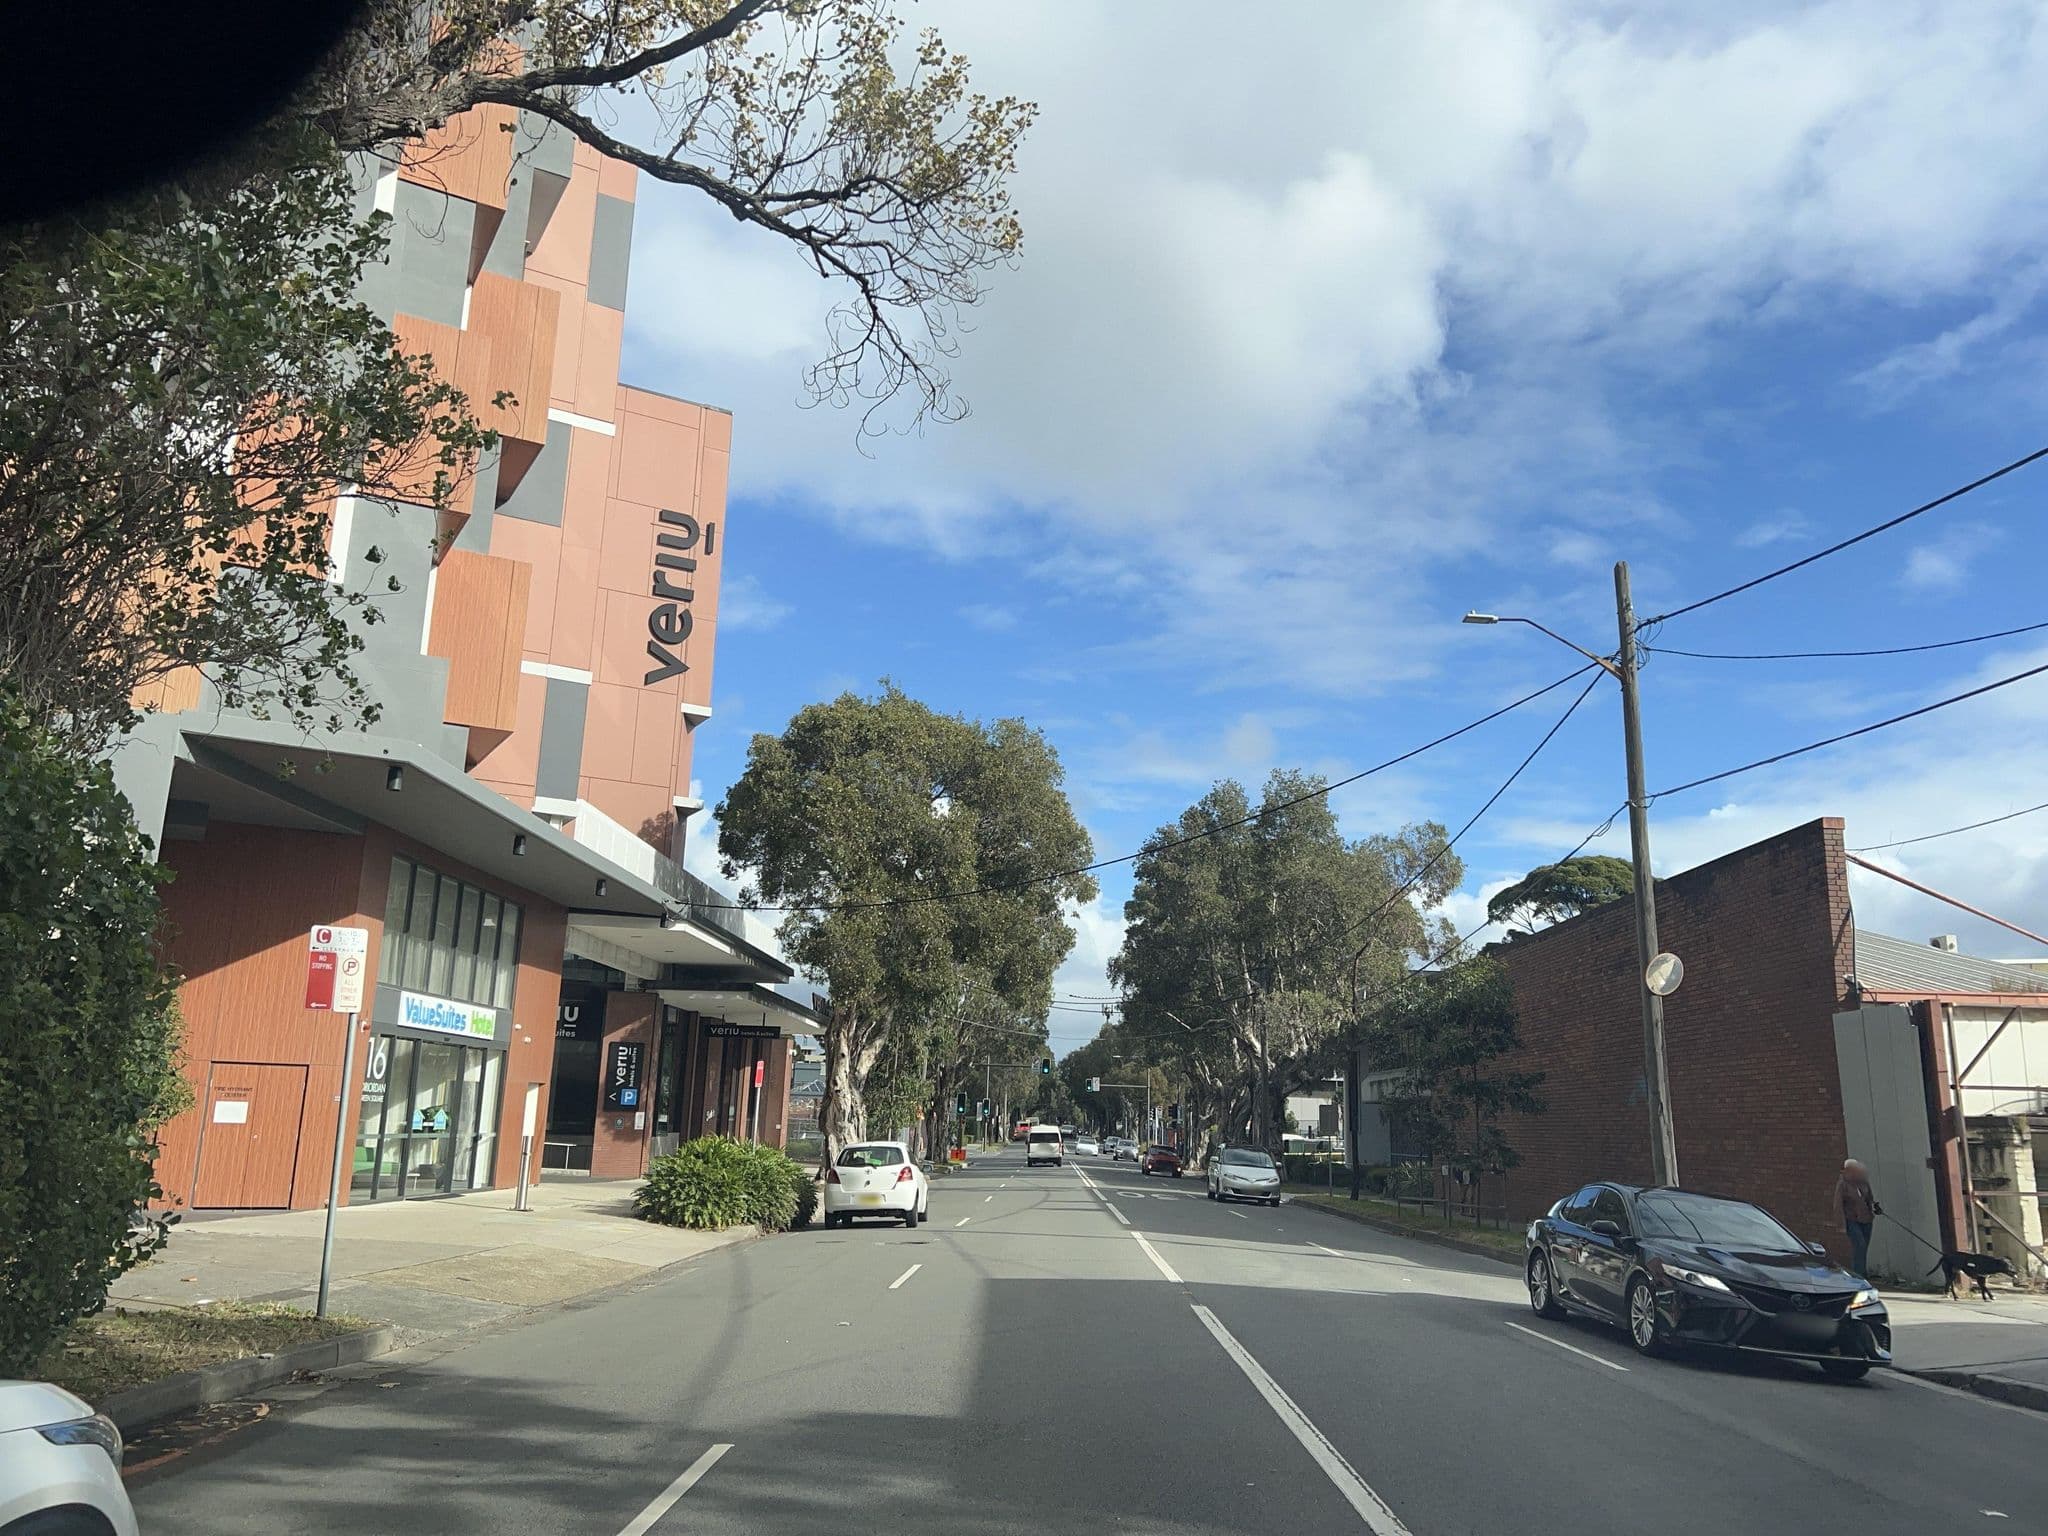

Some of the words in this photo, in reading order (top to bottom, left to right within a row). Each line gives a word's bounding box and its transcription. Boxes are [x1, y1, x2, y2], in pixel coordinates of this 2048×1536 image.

[406, 997, 467, 1032] ValueSuites
[470, 1010, 494, 1036] Hotel
[366, 1037, 389, 1080] 16
